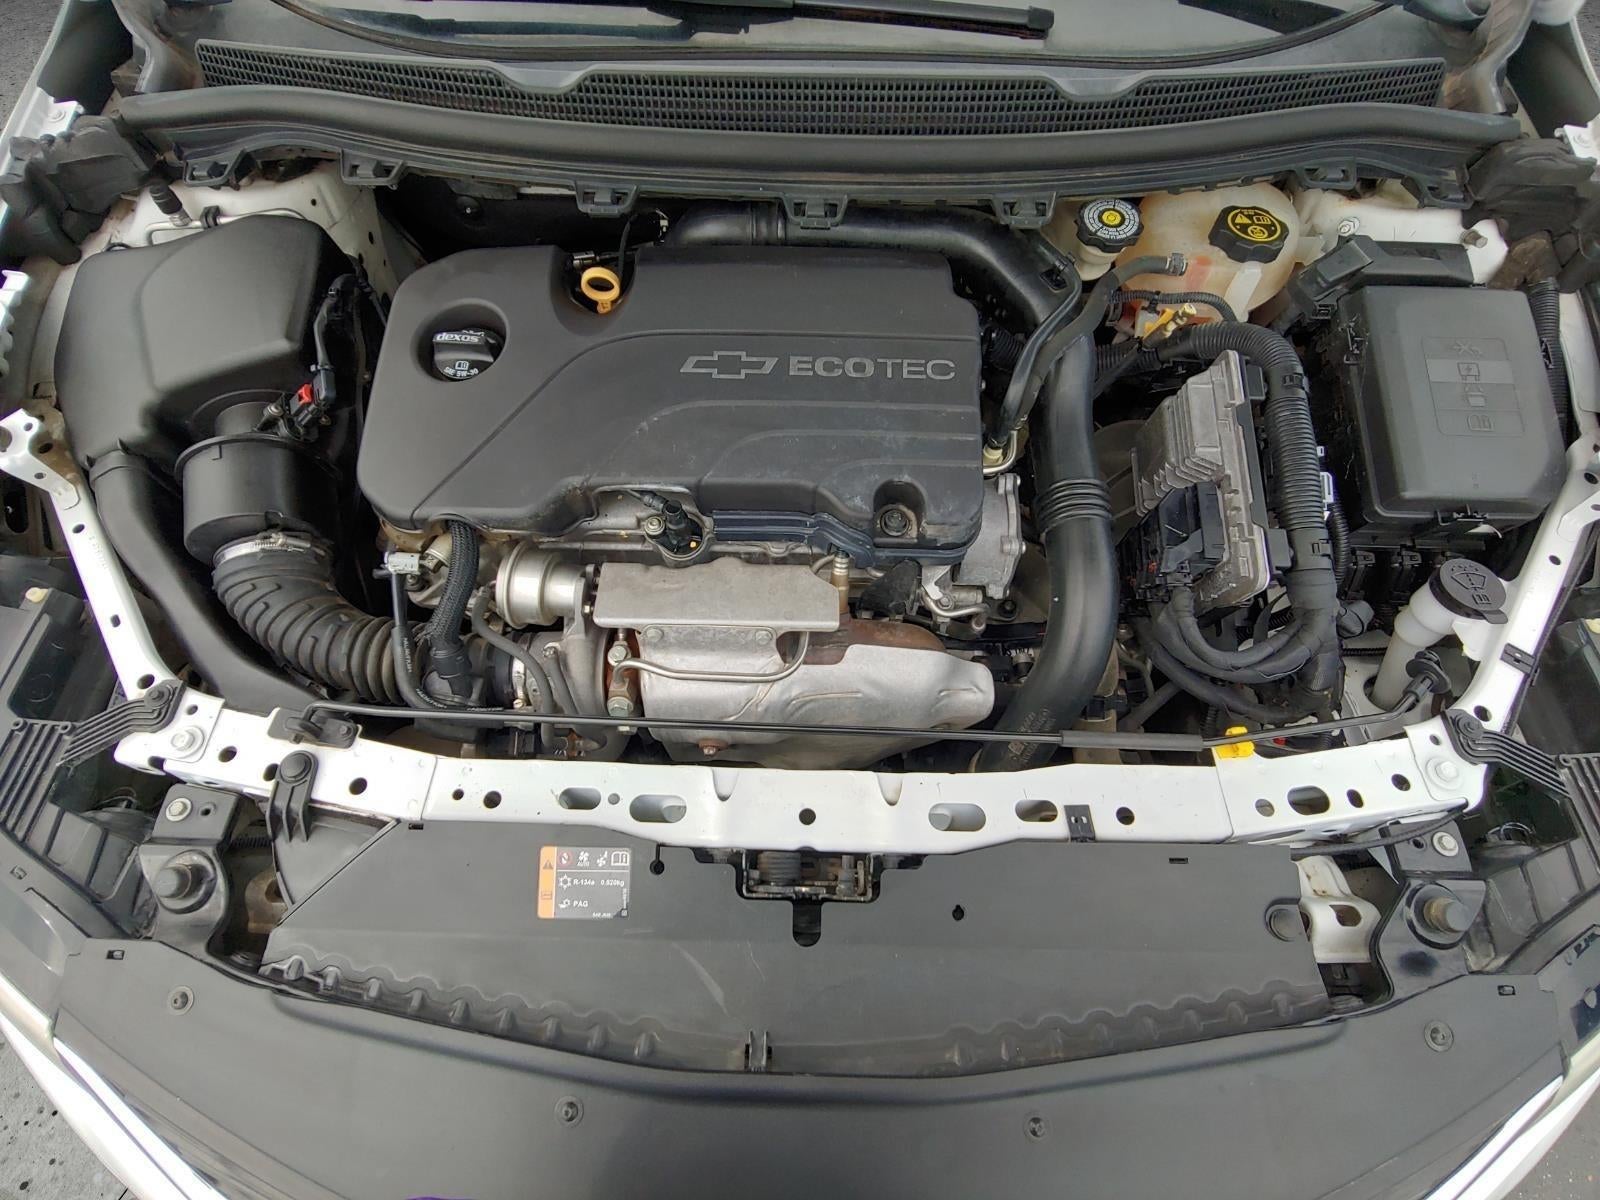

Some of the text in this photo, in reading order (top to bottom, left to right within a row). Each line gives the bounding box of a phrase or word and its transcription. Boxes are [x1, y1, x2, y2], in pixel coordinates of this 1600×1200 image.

[436, 333, 479, 343] dexos
[789, 356, 956, 379] ECOTEC
[456, 368, 479, 377] 5W-30
[573, 878, 595, 886] R-134a
[573, 900, 589, 908] PAG
